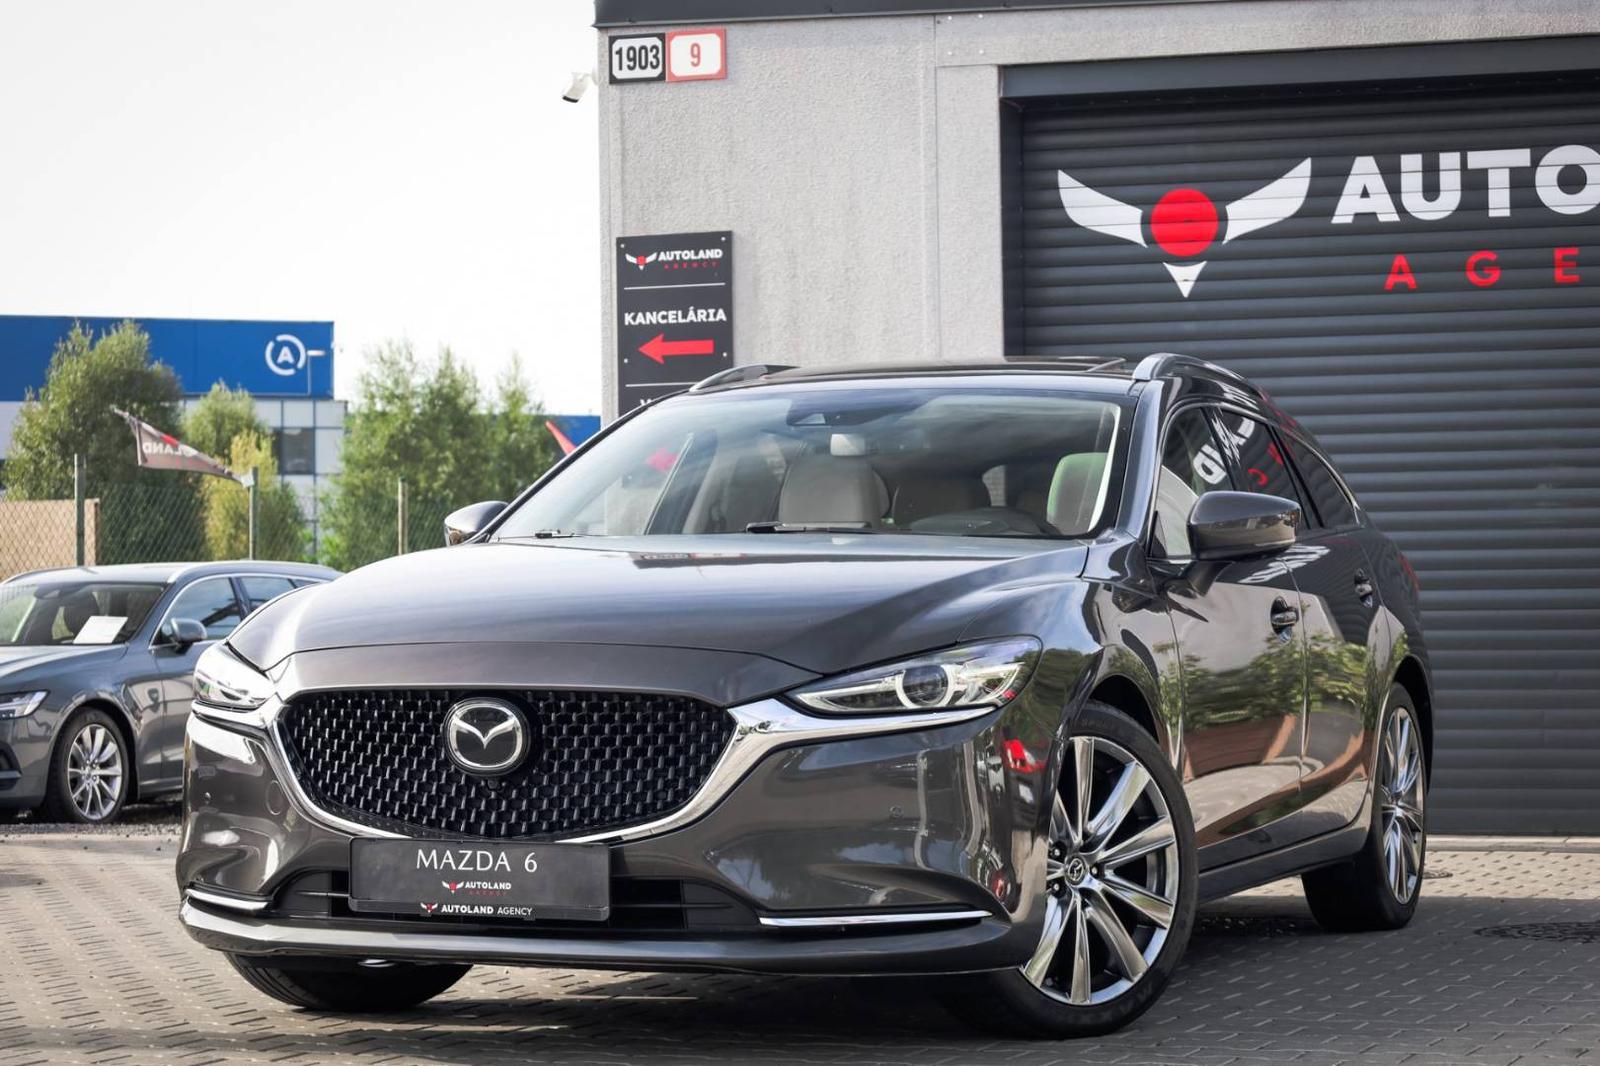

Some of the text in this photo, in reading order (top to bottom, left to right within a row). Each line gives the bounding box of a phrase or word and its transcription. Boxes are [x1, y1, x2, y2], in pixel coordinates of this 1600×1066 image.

[615, 45, 660, 71] 1903
[690, 42, 701, 67] 9
[1331, 144, 1600, 224] AUTO
[658, 249, 723, 261] AUTOLAND
[624, 306, 727, 326] KANCELÁRIA
[416, 849, 538, 873] MAZDA 6
[465, 881, 512, 890] AUTOLAND
[441, 904, 533, 916] AUTOLAND AGENCY
